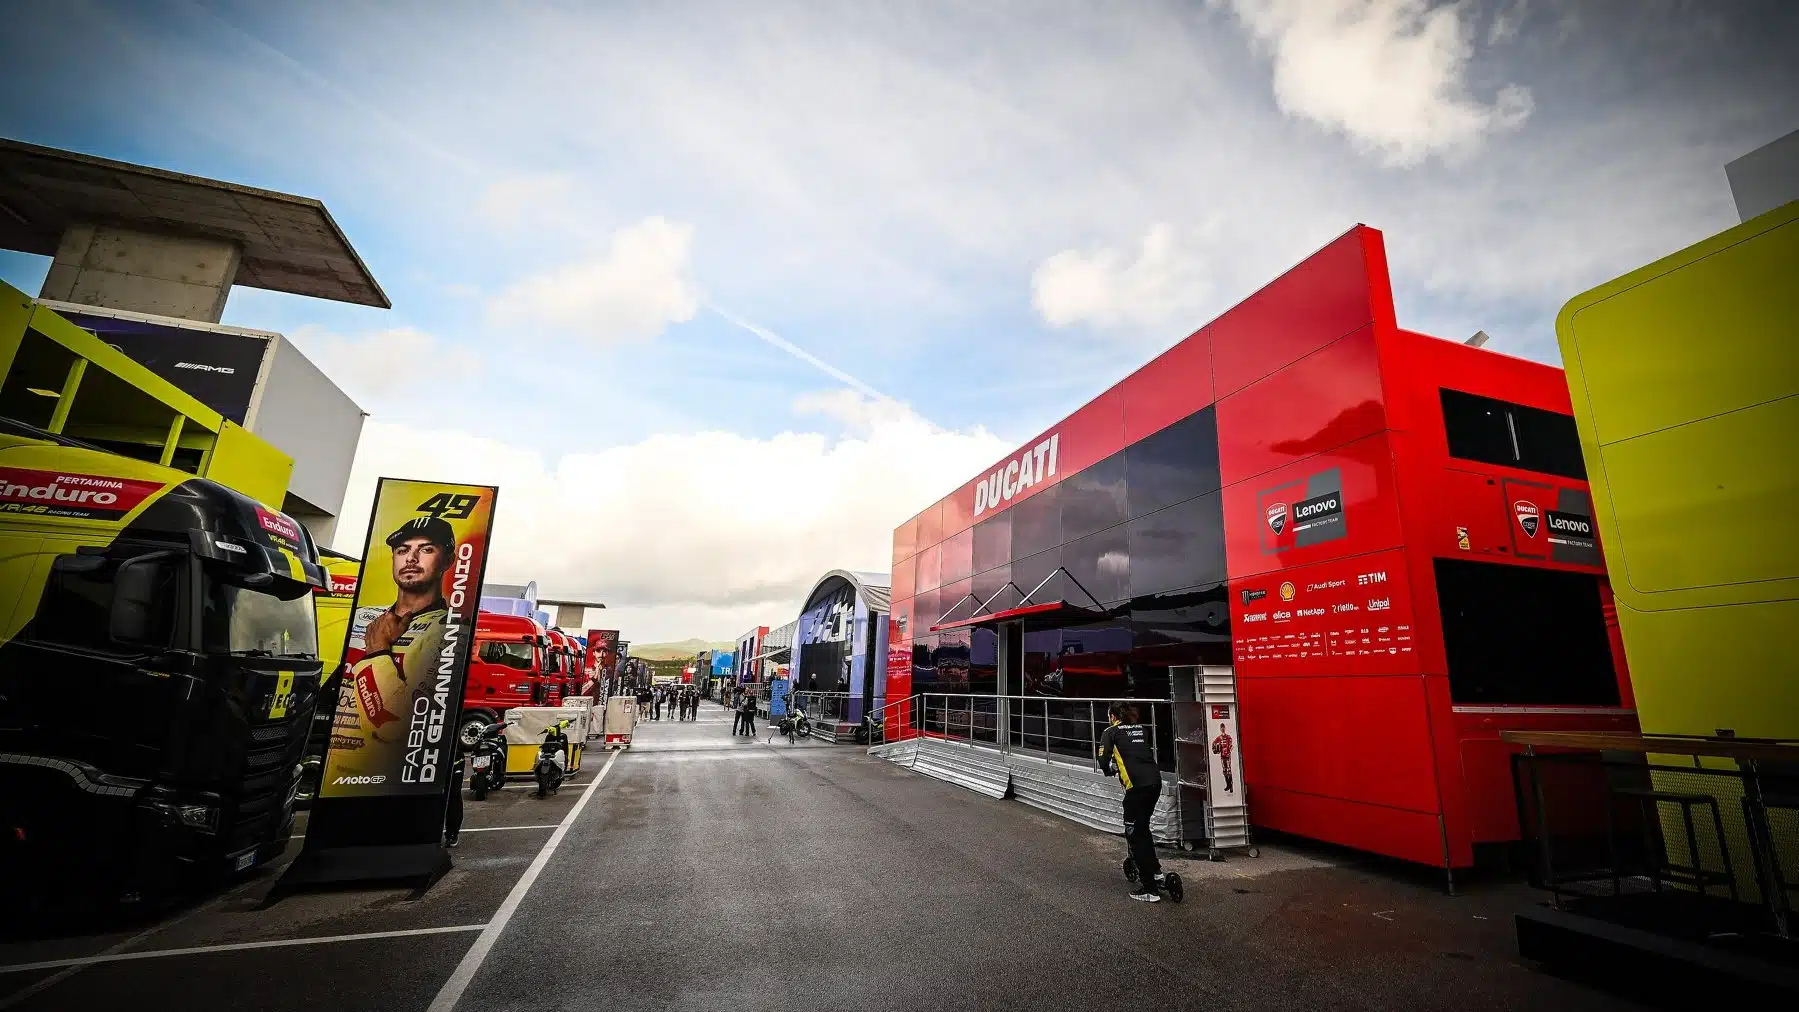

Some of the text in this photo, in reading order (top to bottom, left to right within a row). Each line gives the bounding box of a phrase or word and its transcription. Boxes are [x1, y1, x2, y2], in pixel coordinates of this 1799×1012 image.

[56, 475, 123, 489] PERTAMINA
[973, 432, 1059, 517] DUCATI
[416, 492, 481, 519] 49
[1296, 499, 1337, 518] Lenovo
[1517, 505, 1536, 514] DUCATI
[262, 516, 295, 537] Enduro
[1549, 514, 1589, 533] Lenovo
[1313, 579, 1346, 590] Audi Sport
[1368, 572, 1387, 584] TIM
[1303, 607, 1325, 617] NetApp
[1368, 597, 1390, 611] Unipol
[1272, 610, 1291, 620] elica
[419, 543, 473, 783] DI GIANNANTONIO
[357, 675, 376, 718] Enduro
[402, 696, 430, 783] FABIO
[332, 775, 386, 785] MotoGP
